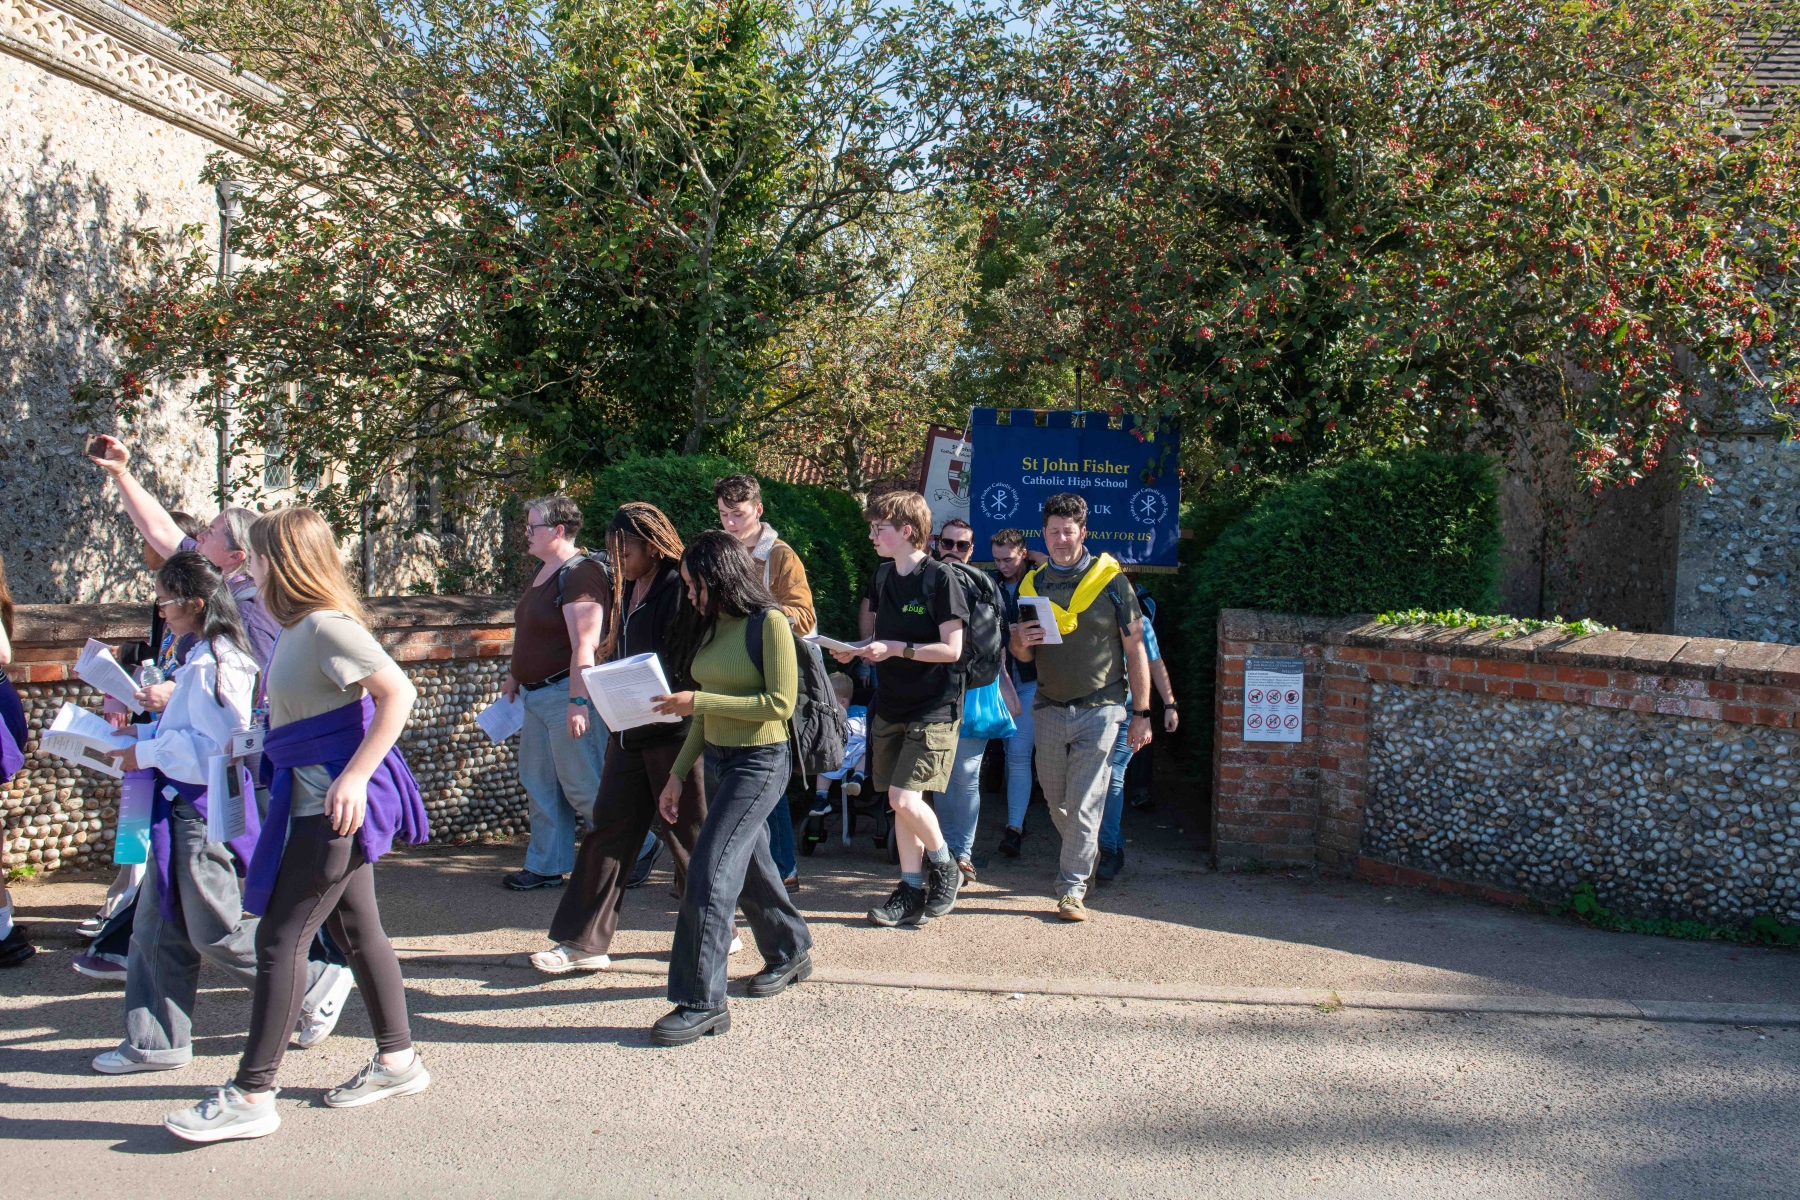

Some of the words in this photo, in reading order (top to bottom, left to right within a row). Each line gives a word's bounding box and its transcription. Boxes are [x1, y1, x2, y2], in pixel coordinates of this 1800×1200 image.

[1022, 457, 1038, 471] St
[1041, 458, 1079, 474] John
[1083, 459, 1130, 474] Fisher
[1022, 475, 1065, 486] Catholic
[1067, 476, 1092, 489] High
[1094, 478, 1128, 488] School
[980, 486, 992, 500] Fisher
[991, 481, 1012, 490] Catholic
[1129, 490, 1141, 504] Fisher
[1140, 487, 1161, 496] Catholic
[1093, 505, 1112, 515] UK
[1085, 530, 1113, 540] PRAY
[1113, 531, 1135, 541] FOR
[1137, 532, 1152, 542] US
